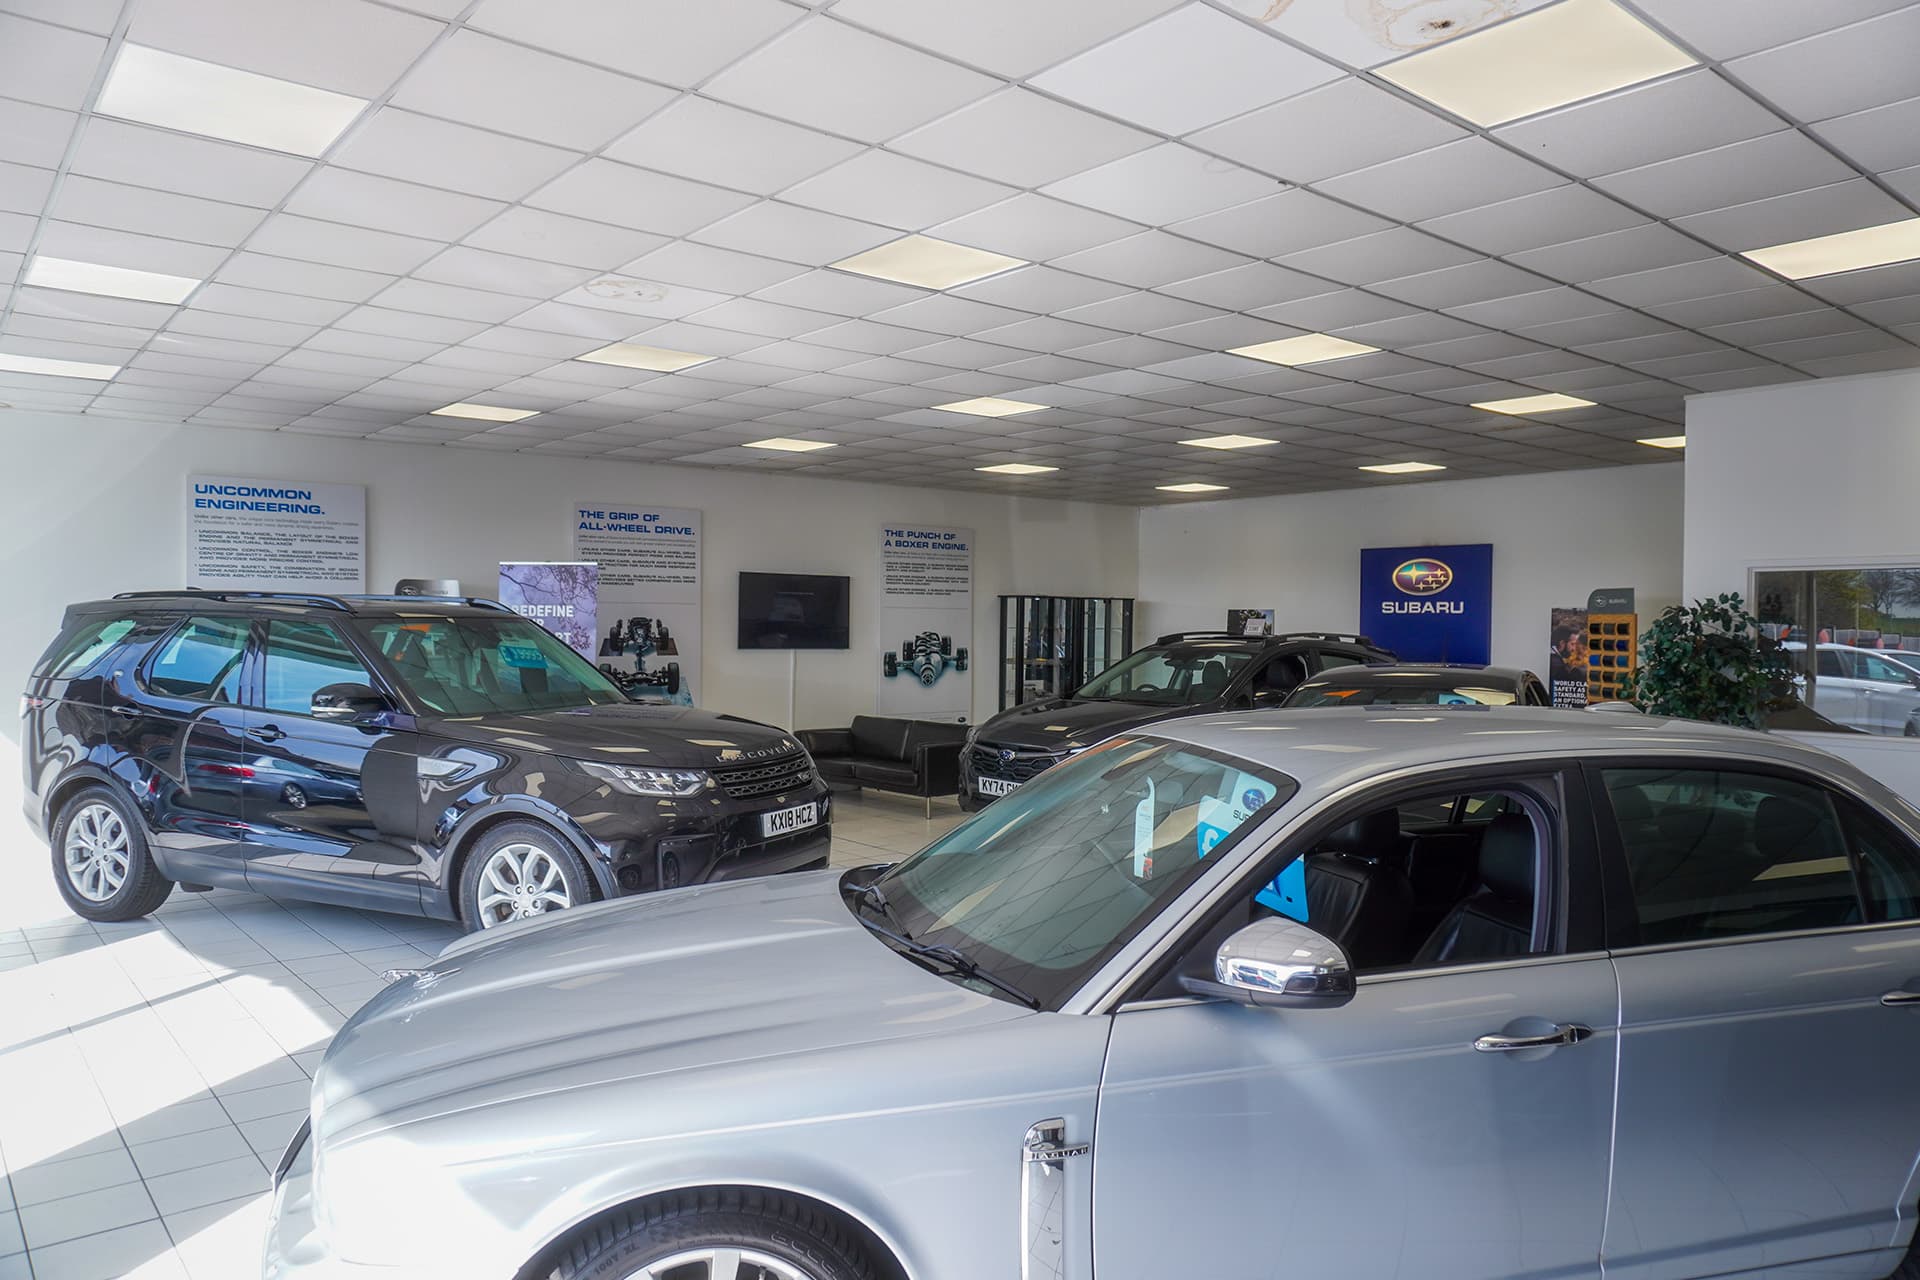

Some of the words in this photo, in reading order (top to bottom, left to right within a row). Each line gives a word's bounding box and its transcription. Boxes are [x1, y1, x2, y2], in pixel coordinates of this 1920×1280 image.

[194, 484, 311, 500] UNCOMMON
[195, 498, 325, 515] ENGINEERING.
[579, 510, 604, 519] THE
[609, 511, 639, 521] GRIP
[655, 526, 695, 535] DRIVE.
[907, 531, 941, 540] PUNCH
[932, 542, 968, 551] ENGINE.
[512, 605, 574, 617] REDEFINE
[1382, 601, 1464, 614] SUBARU
[982, 779, 1004, 793] KY74
[770, 810, 793, 832] KX18
[795, 806, 812, 826] HCZ
[1032, 1146, 1088, 1160] JAGUAR
